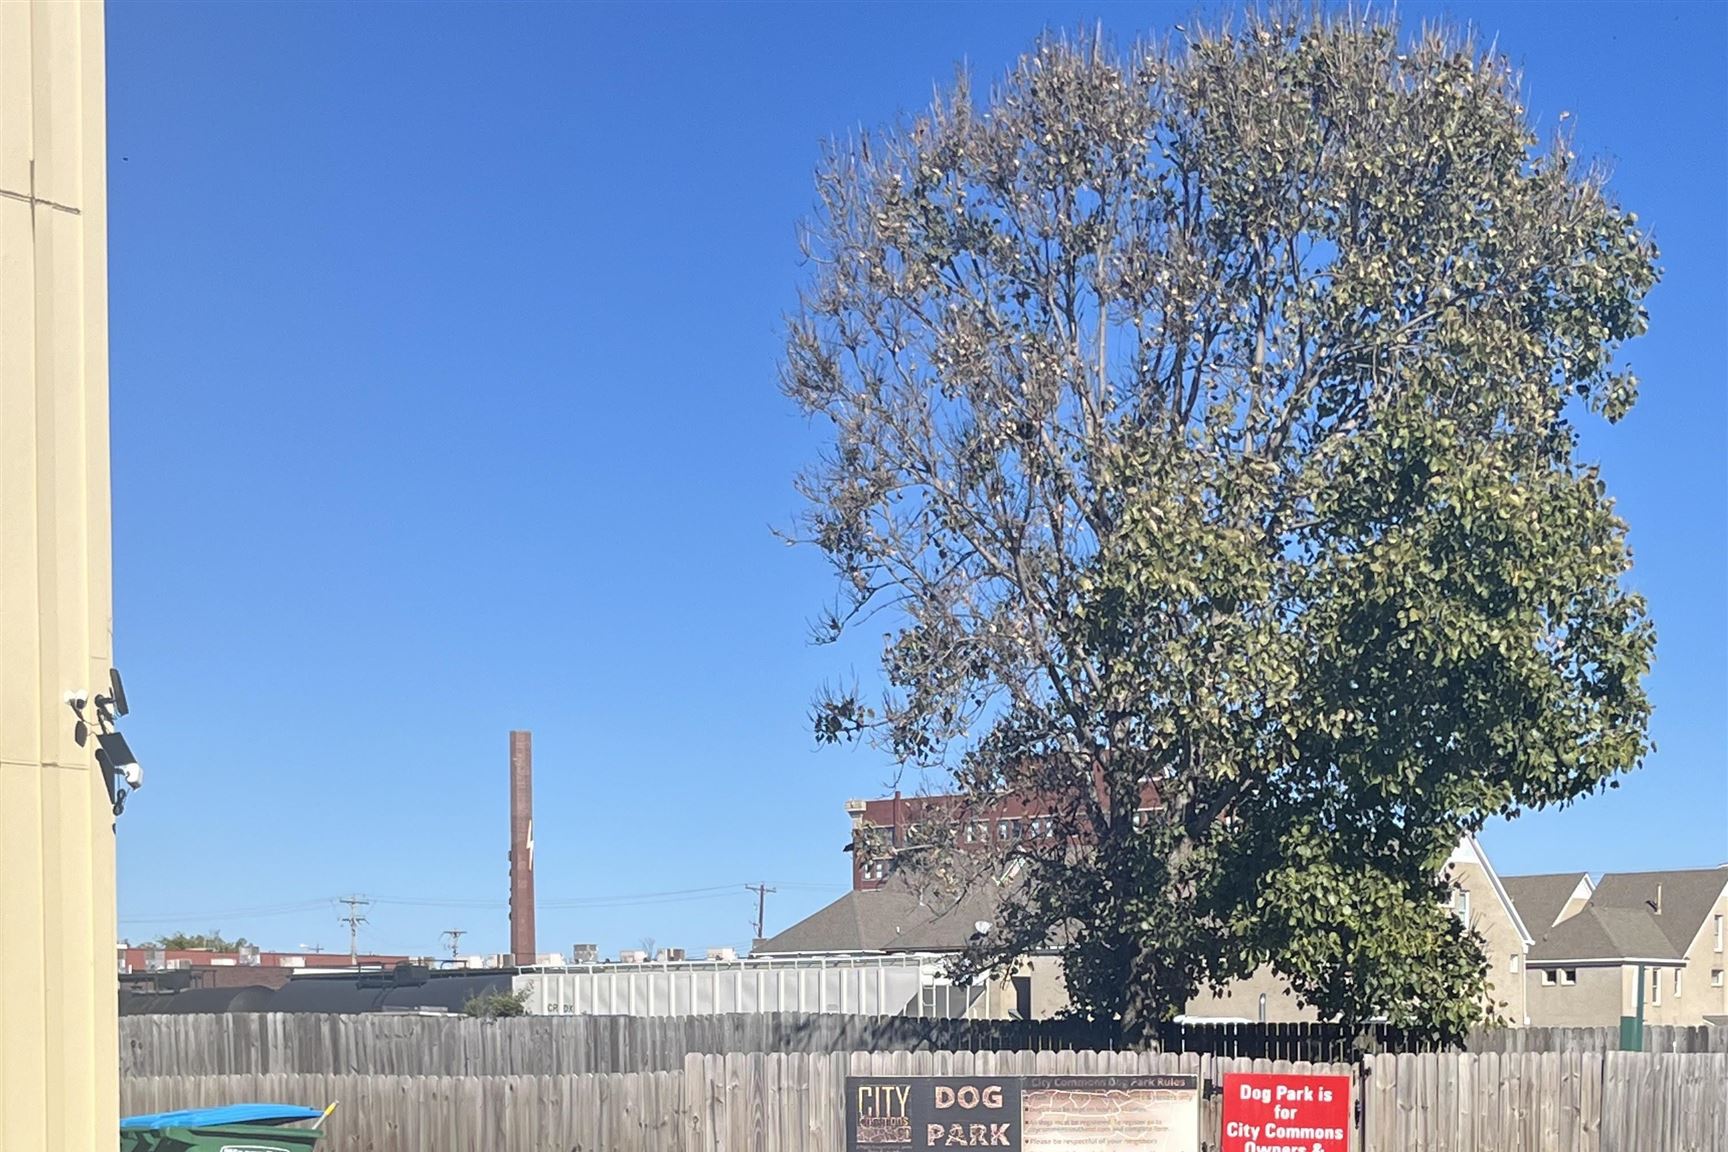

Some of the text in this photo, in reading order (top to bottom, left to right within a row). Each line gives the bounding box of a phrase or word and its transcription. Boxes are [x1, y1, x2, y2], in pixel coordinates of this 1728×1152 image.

[1032, 1078, 1050, 1088] City
[1157, 1078, 1186, 1087] Rules
[858, 1086, 911, 1118] CITY
[935, 1085, 1003, 1109] DOG
[1240, 1084, 1333, 1104] Dog Park is
[1274, 1104, 1298, 1120] for
[927, 1123, 1011, 1147] PARK
[1226, 1121, 1344, 1141] City Commons
[1063, 1138, 1098, 1146] respectful
